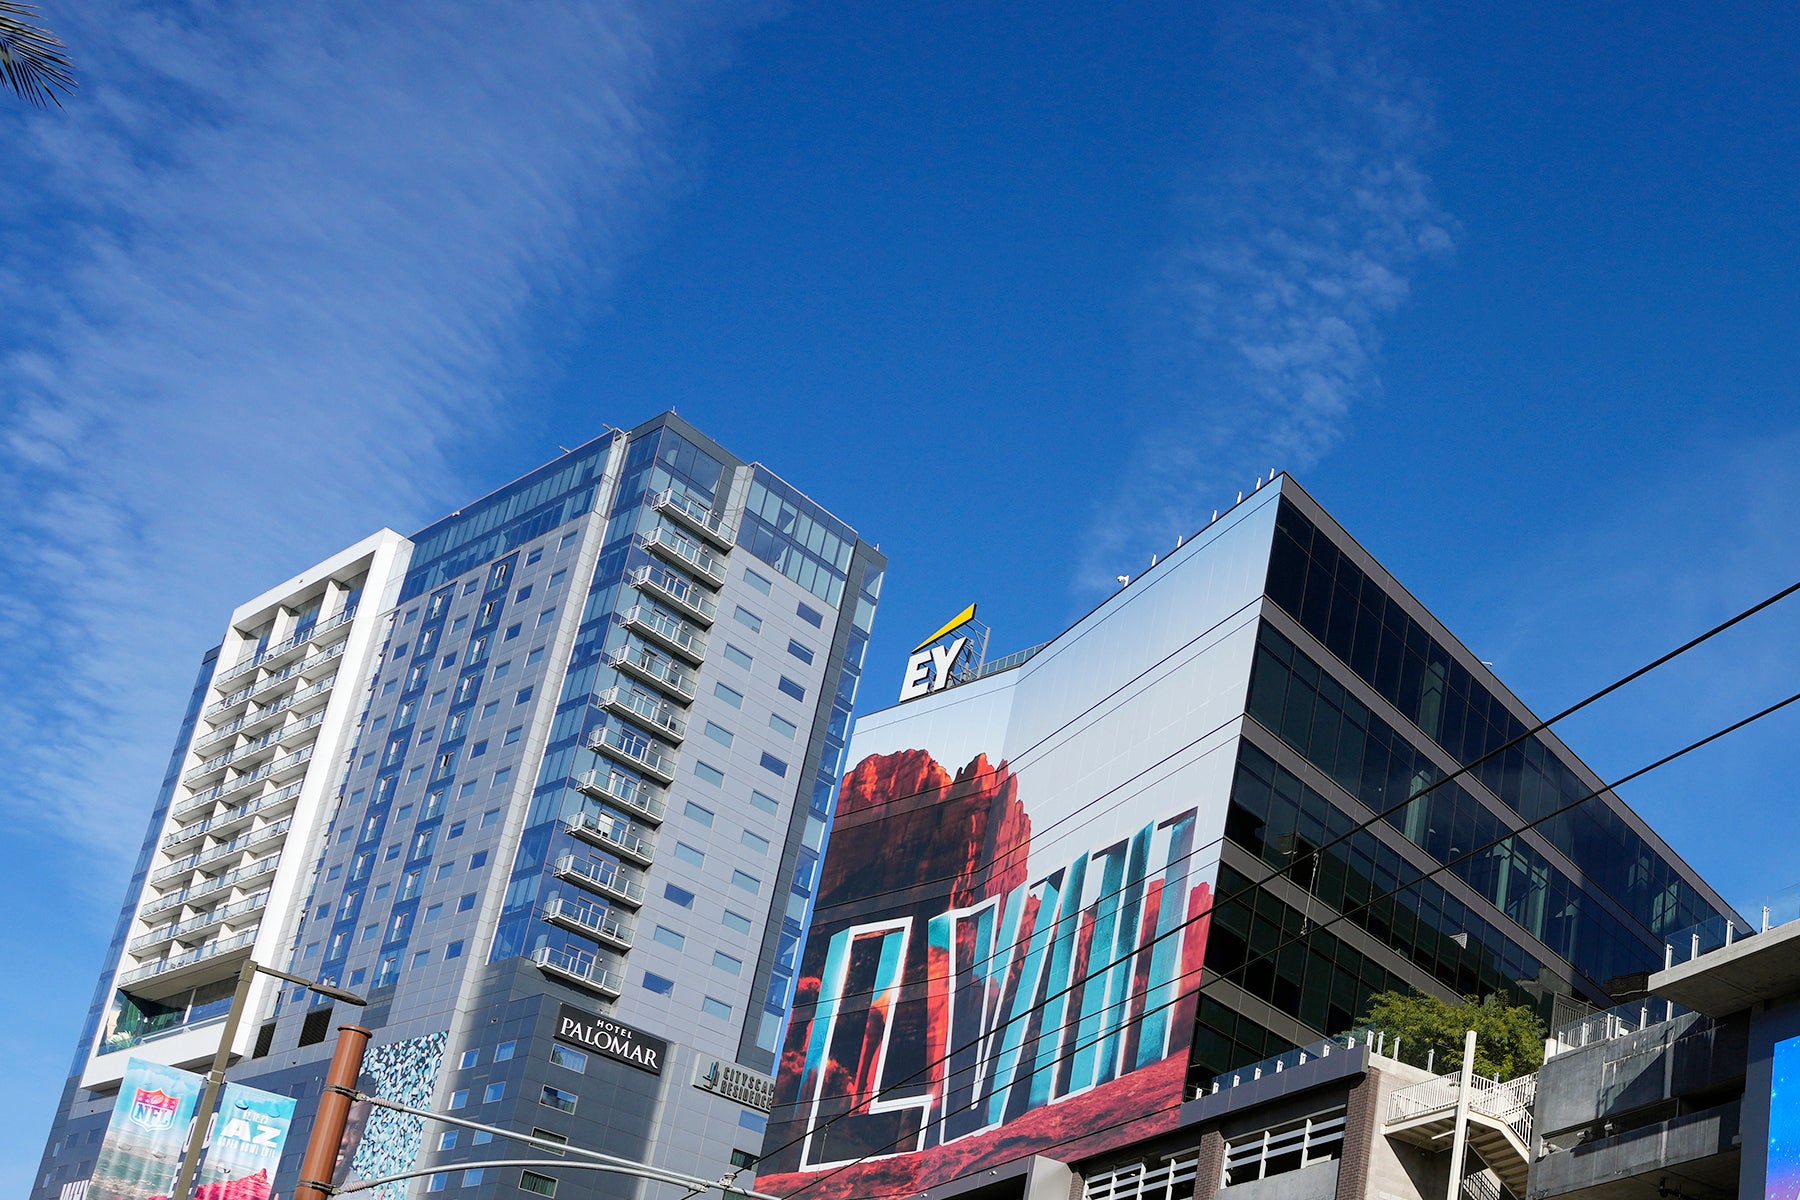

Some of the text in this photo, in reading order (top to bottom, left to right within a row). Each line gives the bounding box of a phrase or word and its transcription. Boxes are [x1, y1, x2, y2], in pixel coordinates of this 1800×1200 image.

[900, 637, 966, 702] EY
[560, 1017, 658, 1069] PALOMAR
[597, 1019, 632, 1039] HOTEL
[722, 1066, 776, 1095] CITYSCAP
[719, 1083, 774, 1110] RESIDENCE
[136, 1103, 173, 1125] NFL
[218, 1137, 240, 1149] SUPER
[242, 1141, 260, 1154] BOWL
[219, 1118, 282, 1149] AZ
